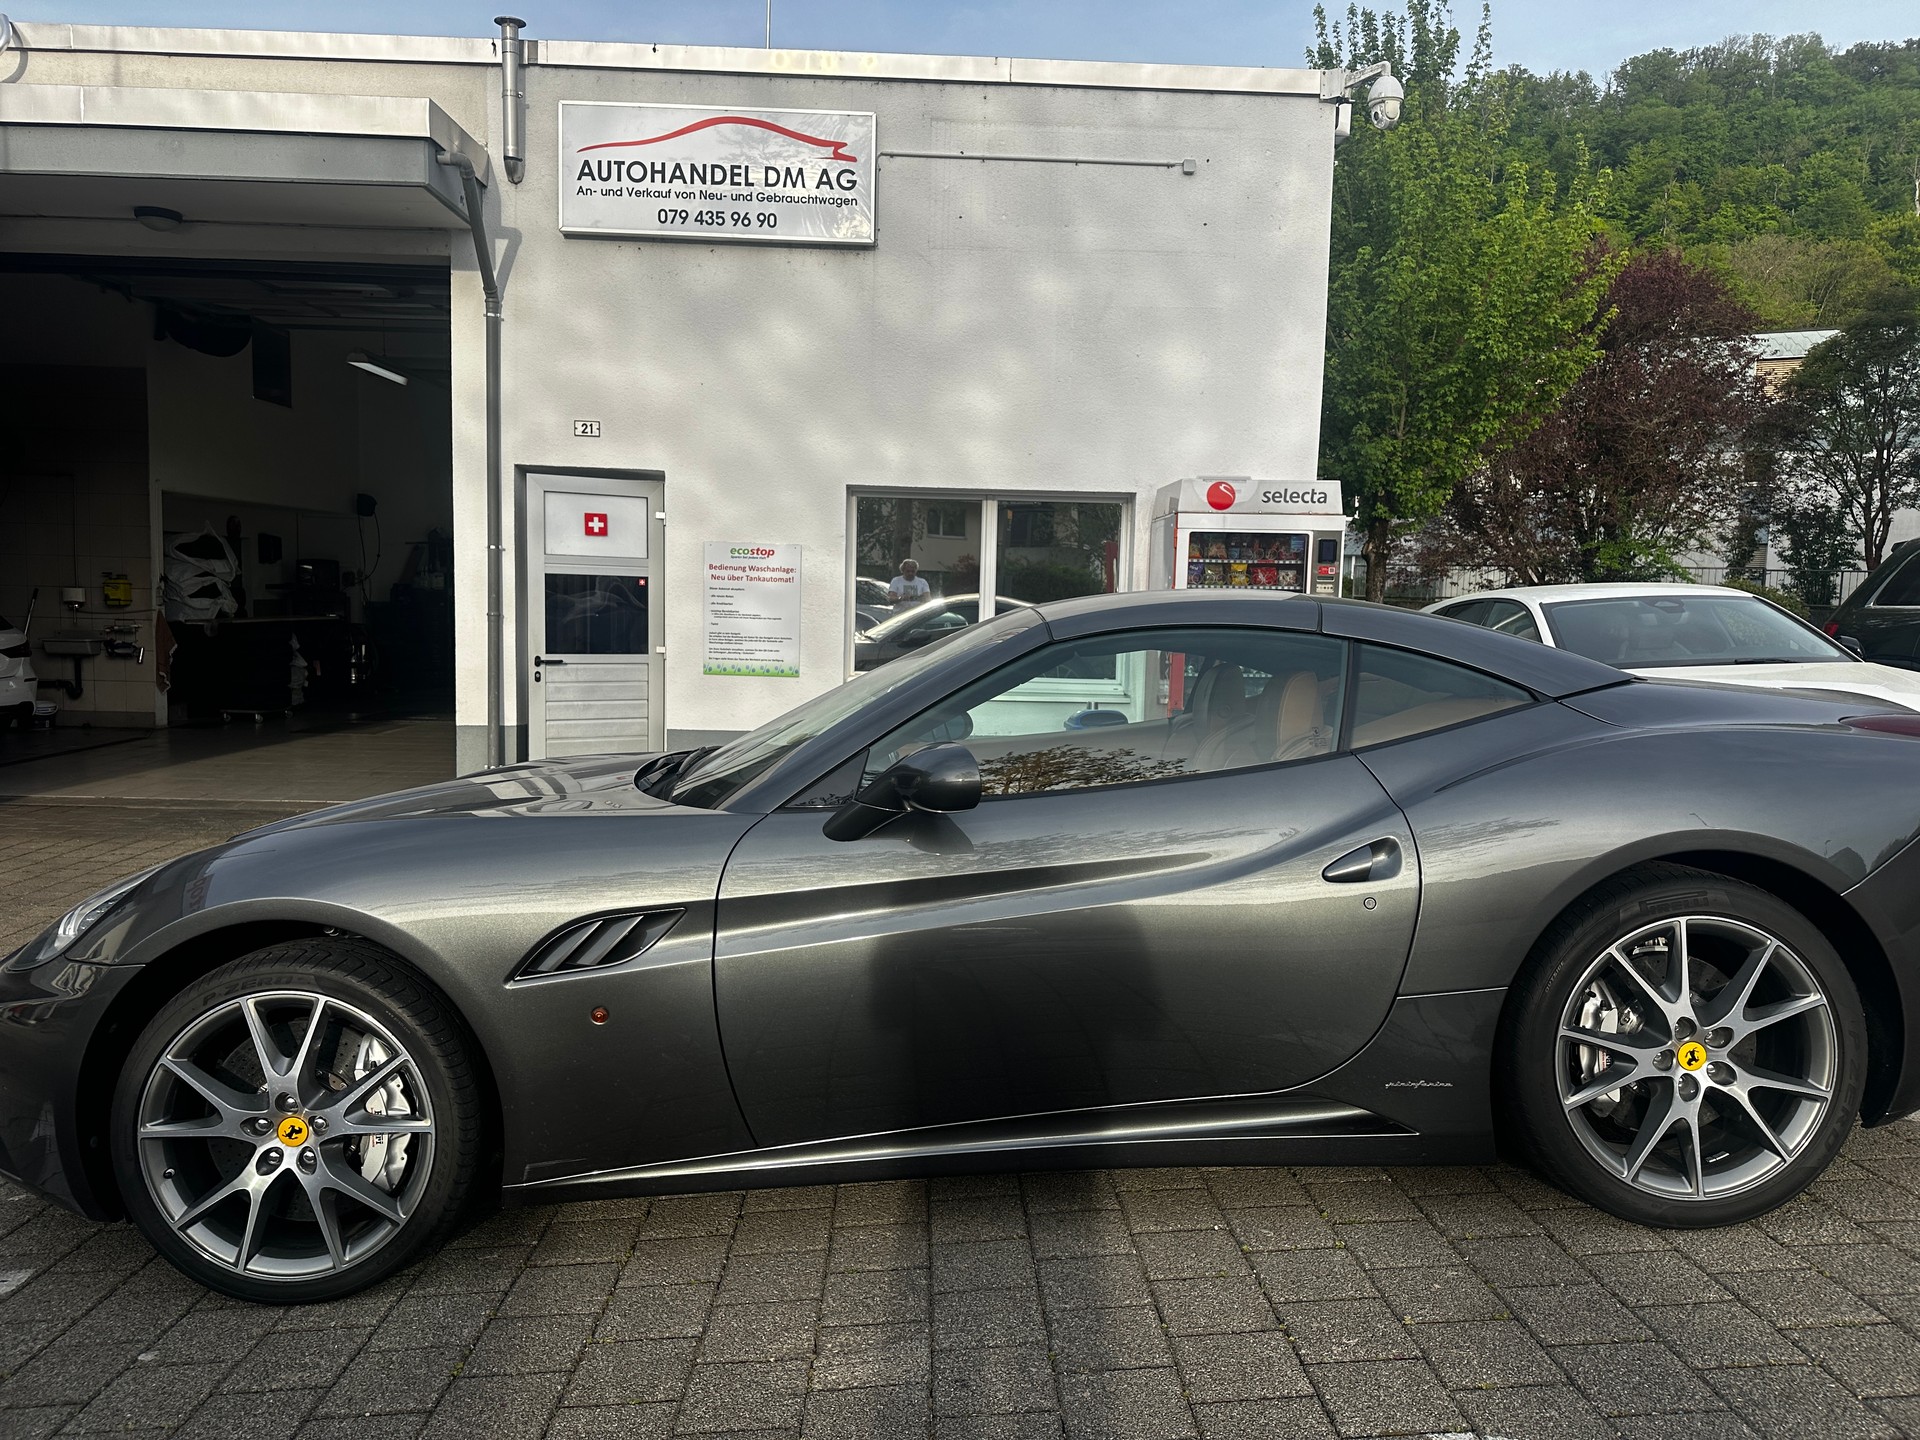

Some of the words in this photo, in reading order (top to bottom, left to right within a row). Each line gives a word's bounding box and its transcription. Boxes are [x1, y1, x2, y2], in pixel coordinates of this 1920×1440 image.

[576, 159, 755, 187] AUTOHANDEL
[764, 165, 807, 189] DM
[815, 168, 858, 191] AG
[576, 185, 598, 196] An-
[600, 187, 623, 197] und
[626, 187, 672, 199] Verkauf
[674, 190, 696, 200] von
[699, 190, 728, 201] Neu-
[730, 191, 753, 202] und
[755, 191, 858, 208] Gebrauchtwagen
[657, 208, 690, 225] 079
[694, 210, 726, 227] 435
[730, 211, 752, 228] 96
[756, 212, 778, 229] 90
[581, 423, 593, 434] 21
[1261, 488, 1328, 504] selecta
[730, 547, 775, 557] ecostop
[708, 563, 747, 573] Bedienung
[748, 565, 797, 574] Waschanlage:
[727, 574, 744, 582] über
[745, 575, 795, 583] Tankautomat!
